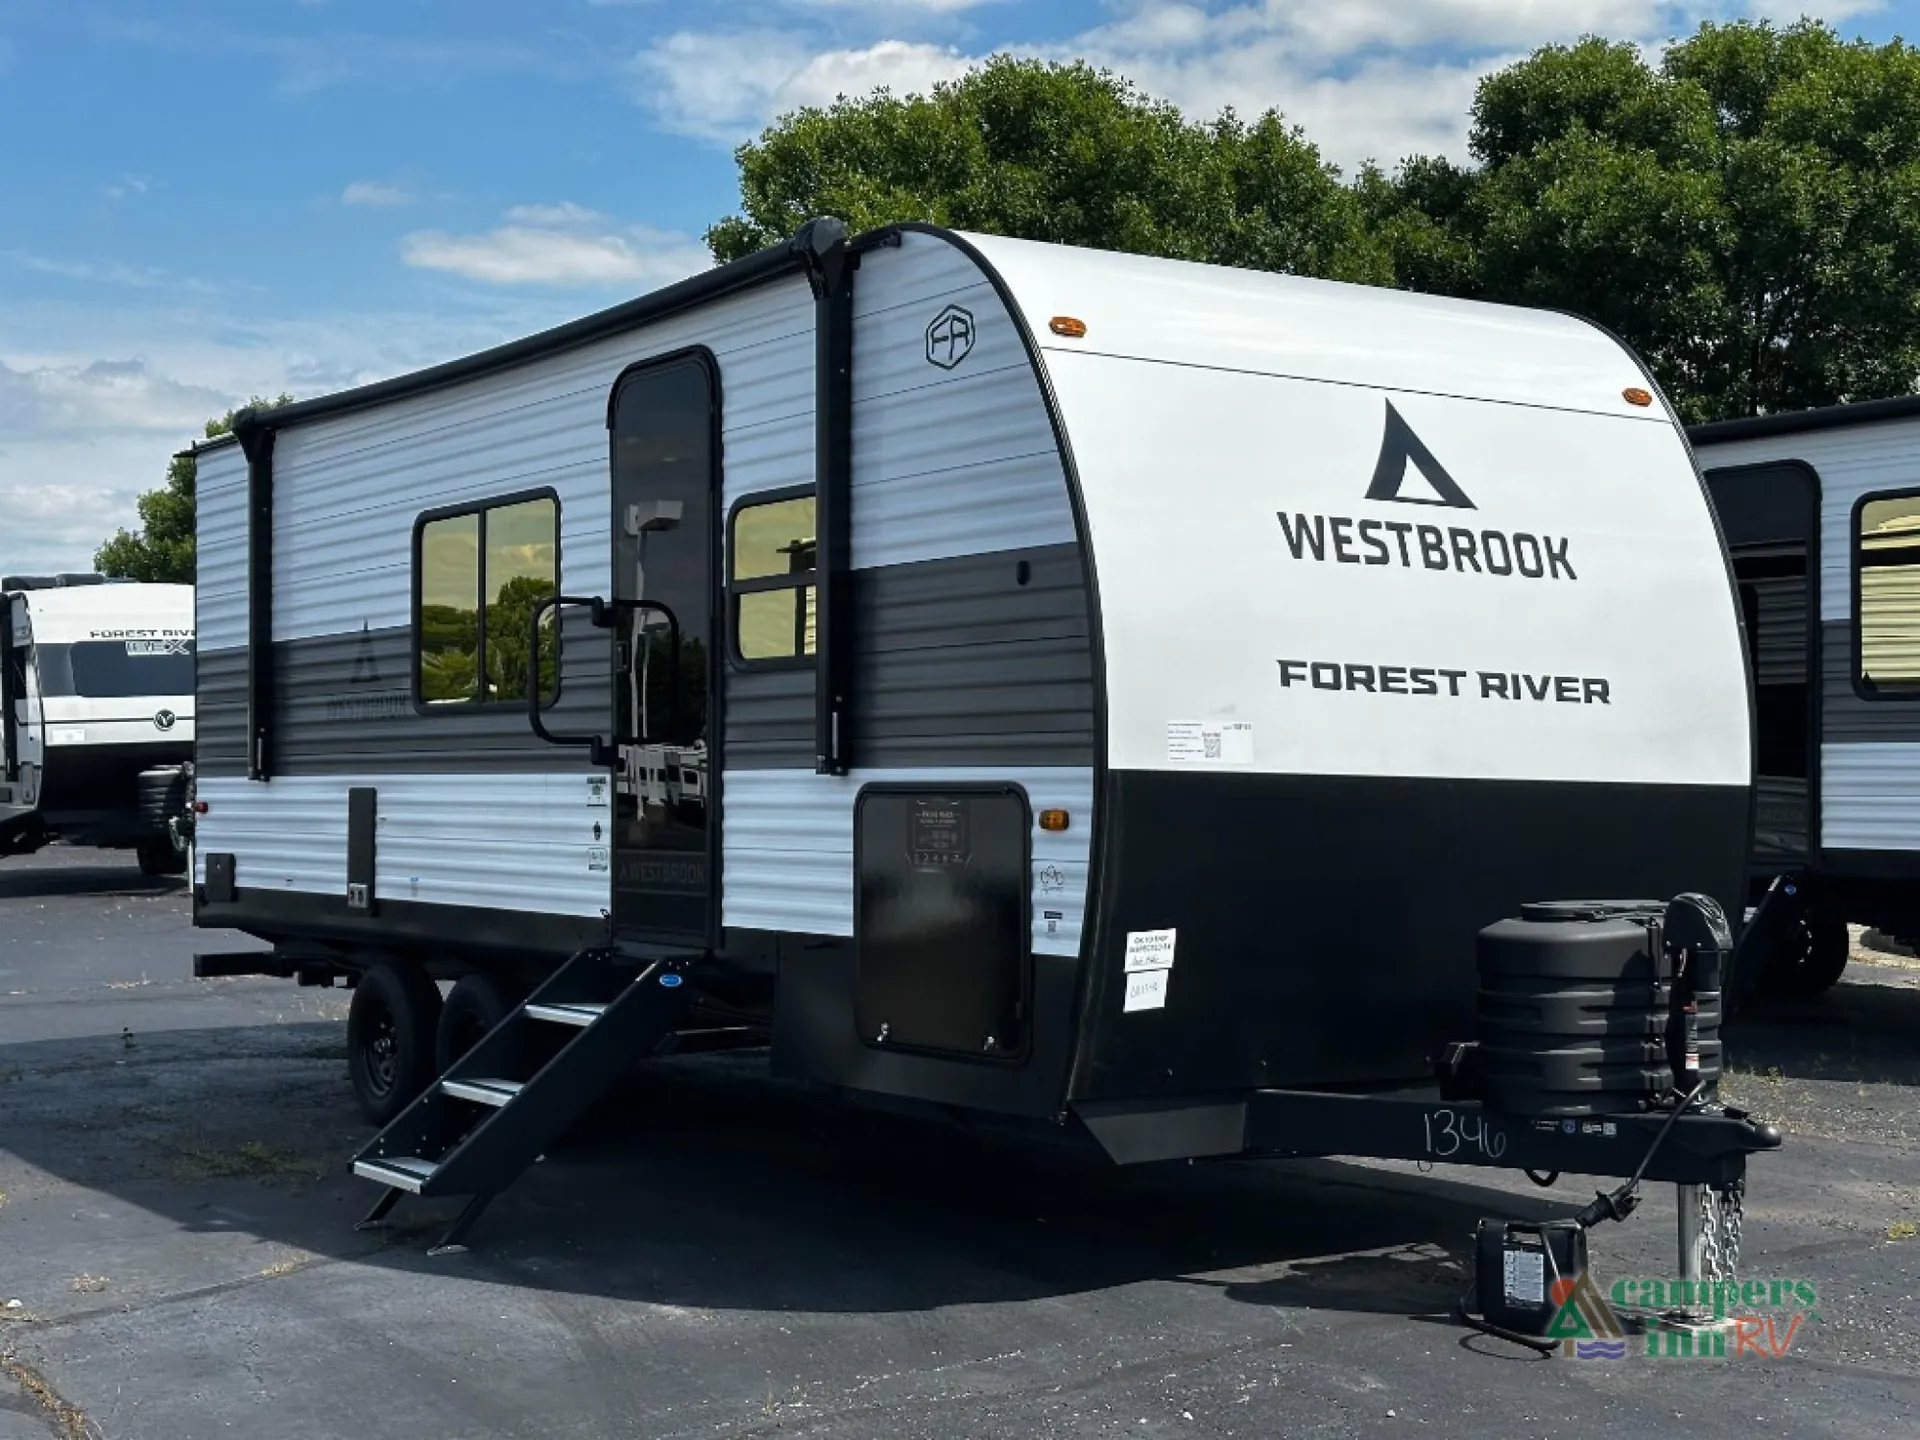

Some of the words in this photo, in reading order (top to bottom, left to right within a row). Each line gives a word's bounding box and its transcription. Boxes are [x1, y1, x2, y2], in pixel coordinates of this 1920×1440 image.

[1276, 511, 1578, 580] WESTBROOK
[89, 629, 158, 638] FOREST
[1276, 659, 1467, 697] FOREST
[1476, 670, 1611, 704] RIVER
[630, 860, 705, 886] WESTBROOK
[1424, 1109, 1507, 1158] 1346
